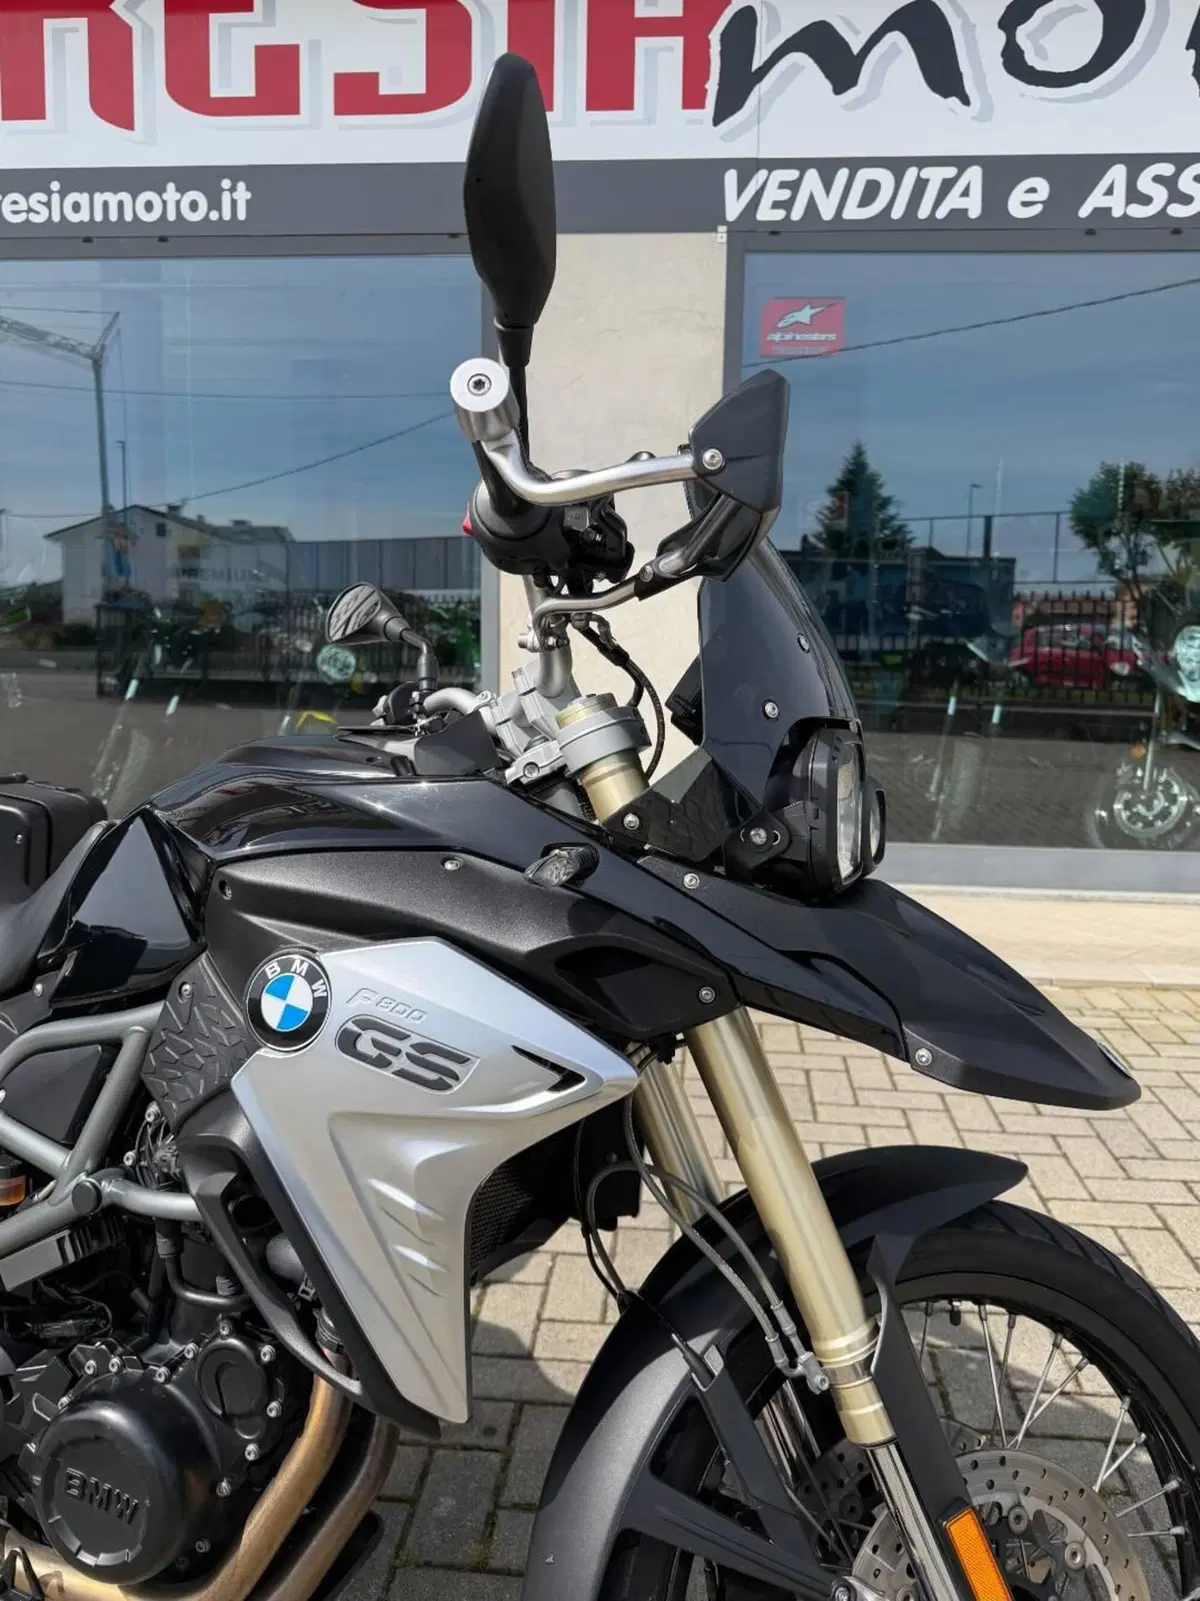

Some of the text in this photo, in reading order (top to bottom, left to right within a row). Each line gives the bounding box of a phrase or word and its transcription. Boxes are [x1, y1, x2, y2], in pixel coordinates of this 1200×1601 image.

[0, 178, 252, 223] esiamoto.it
[723, 162, 1200, 221] VENDITA e ASS
[264, 958, 328, 999] BMW
[346, 987, 428, 1024] F 800
[335, 1014, 480, 1092] GS
[64, 1466, 140, 1525] BMW
